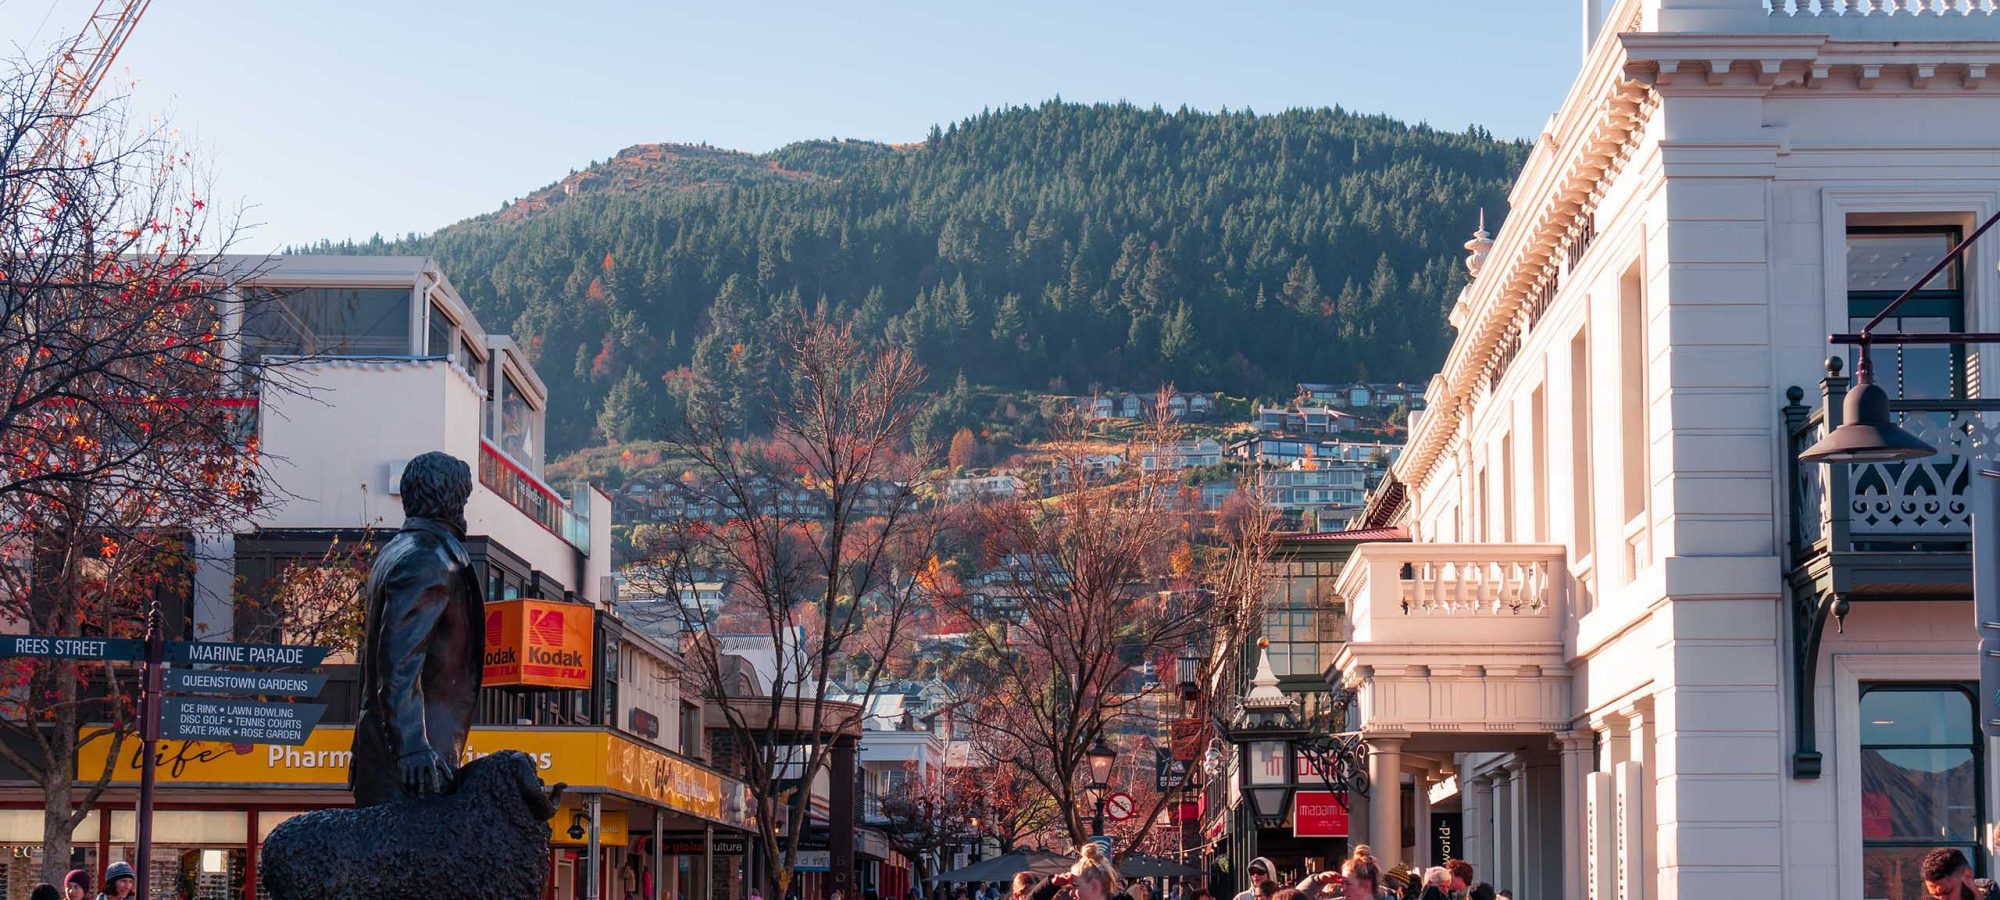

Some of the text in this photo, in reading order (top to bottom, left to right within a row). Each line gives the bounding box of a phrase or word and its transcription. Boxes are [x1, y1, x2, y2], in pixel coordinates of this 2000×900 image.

[15, 638, 107, 657] REES STREET
[189, 645, 303, 664] MARINE PARADE
[485, 647, 516, 666] odak
[528, 646, 583, 668] Kodak
[561, 668, 587, 680] FILM
[182, 675, 308, 692] QUEENSTOWN GARDENS
[181, 703, 294, 718] ICE RINK LAWN BOWLING
[180, 714, 302, 730] DISC GOLF TENNIS COURTS
[179, 724, 301, 740] SKATE PARK ROSE GARDEN
[713, 841, 743, 852] ulture
